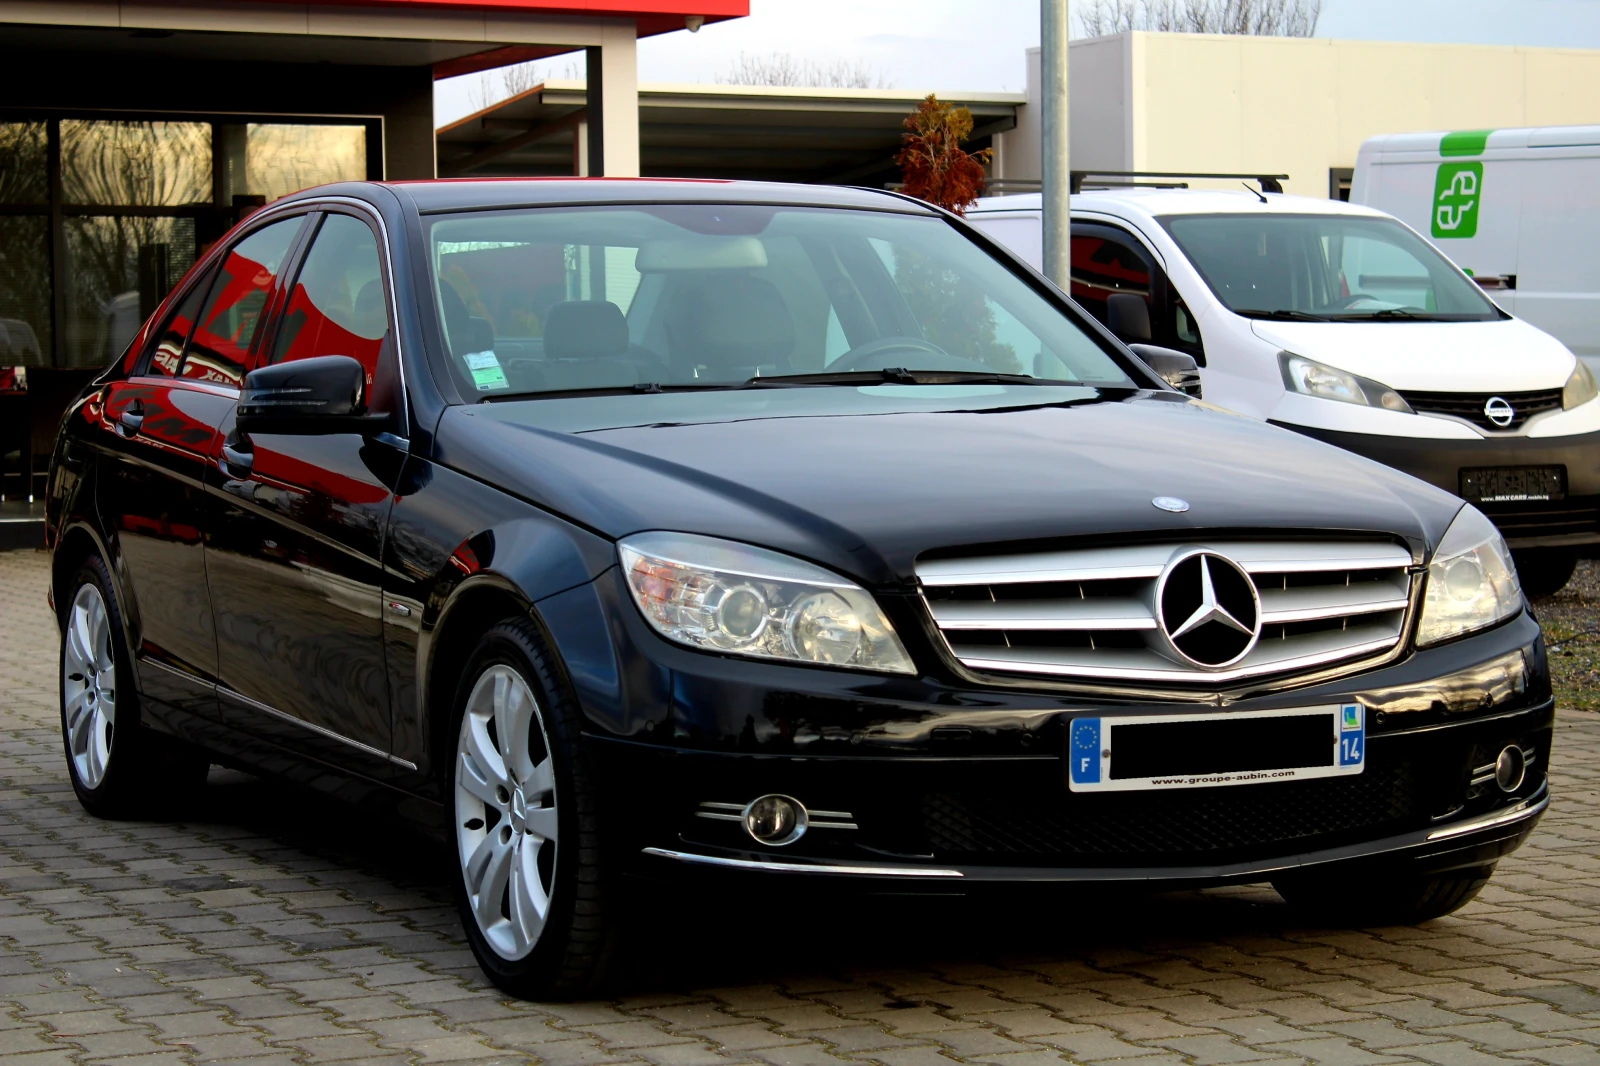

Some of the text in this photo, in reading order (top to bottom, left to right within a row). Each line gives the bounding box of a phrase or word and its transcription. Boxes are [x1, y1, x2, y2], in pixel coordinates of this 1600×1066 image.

[1342, 737, 1360, 761] 14
[1081, 758, 1091, 773] F
[1151, 770, 1295, 785] www.groupe-aubin.com
